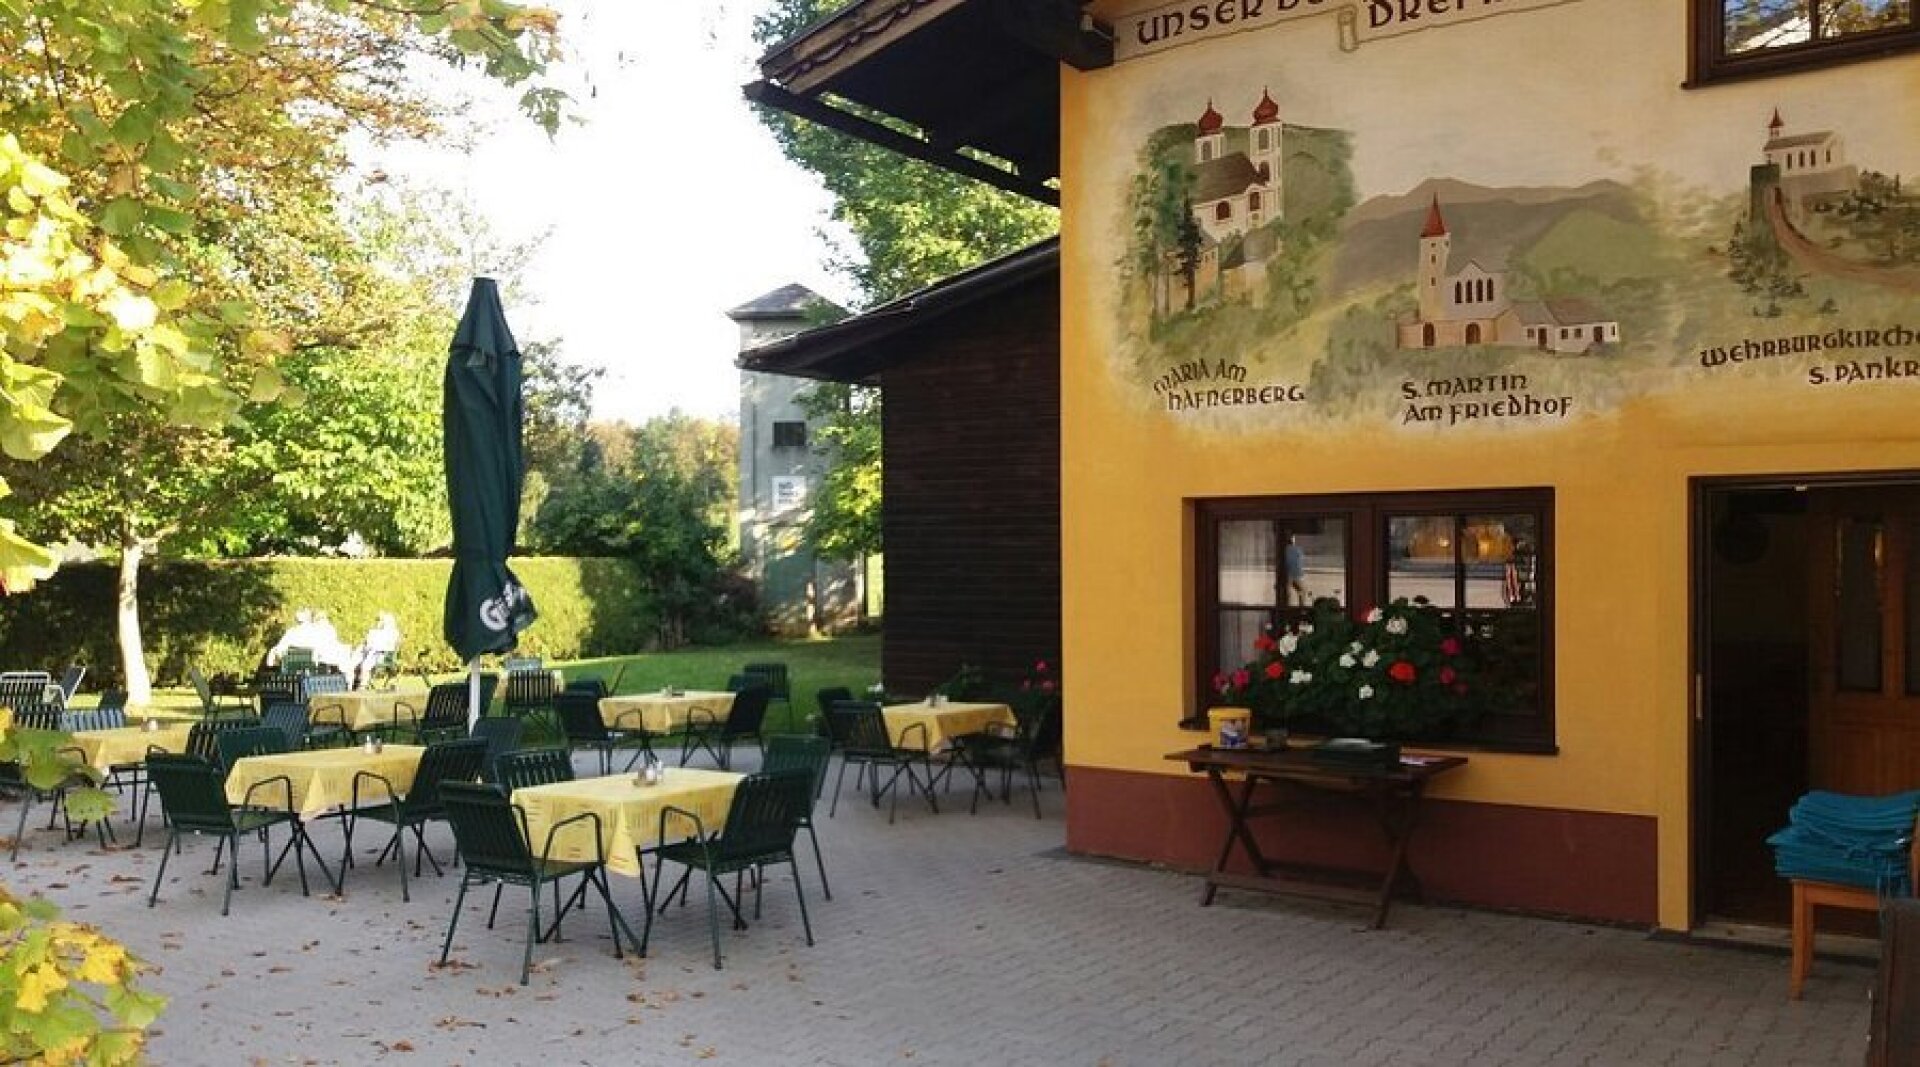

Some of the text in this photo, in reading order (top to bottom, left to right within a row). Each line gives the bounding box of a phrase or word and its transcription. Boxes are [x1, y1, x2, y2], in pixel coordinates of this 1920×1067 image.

[1137, 0, 1262, 45] UNSER
[1700, 324, 1920, 367] WEHRBURGKIRCH
[1401, 375, 1528, 400] S. MARTIN
[1809, 366, 1830, 384] S.
[1451, 394, 1573, 425] FRIEDHOF
